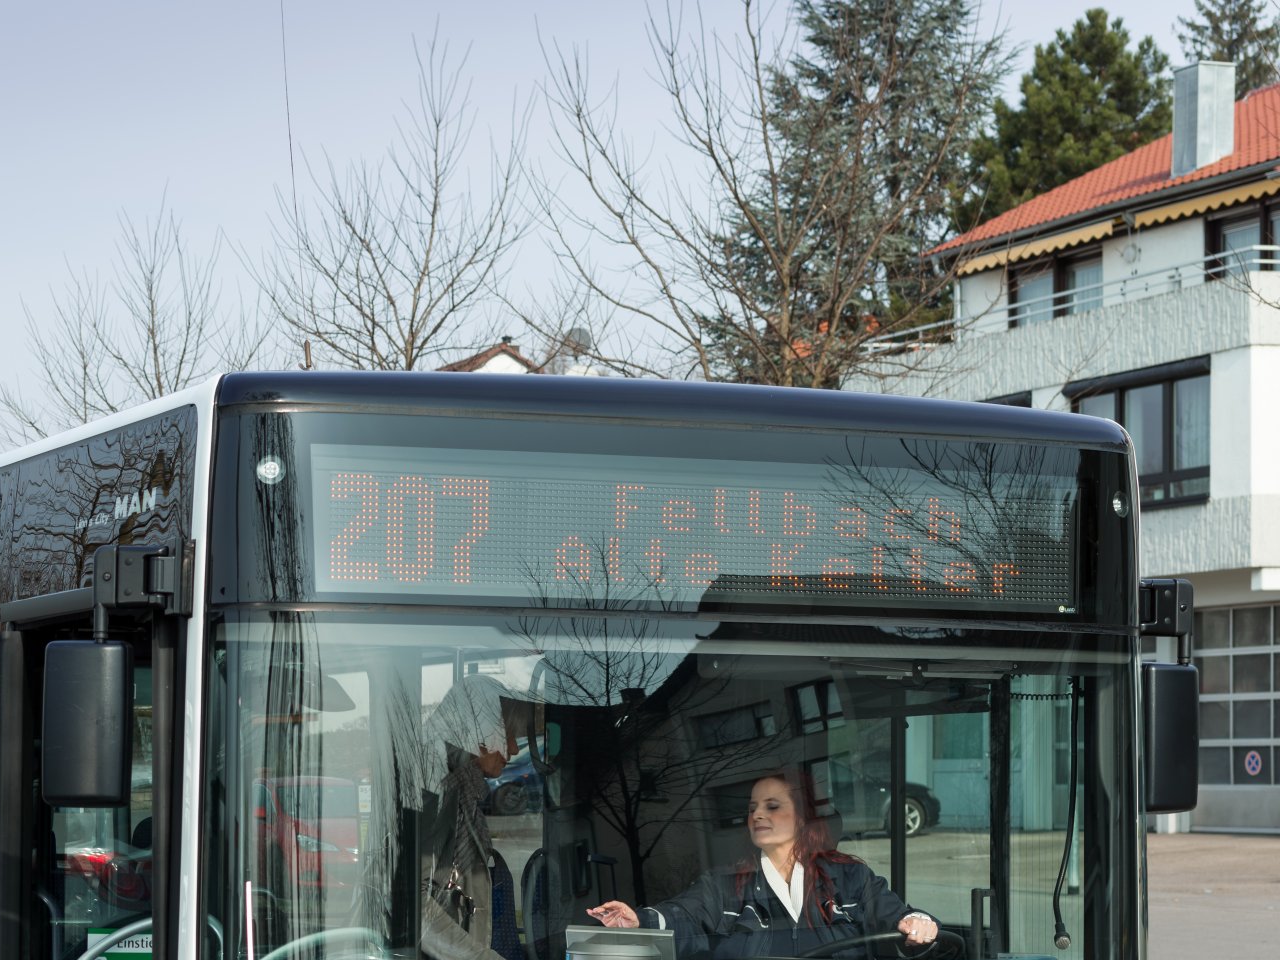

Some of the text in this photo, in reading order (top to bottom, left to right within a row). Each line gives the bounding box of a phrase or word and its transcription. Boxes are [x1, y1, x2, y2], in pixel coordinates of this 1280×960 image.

[115, 486, 158, 520] MAN
[330, 473, 490, 583] 207
[615, 484, 962, 542] Fellbach
[555, 535, 1020, 594] Alte Kelter
